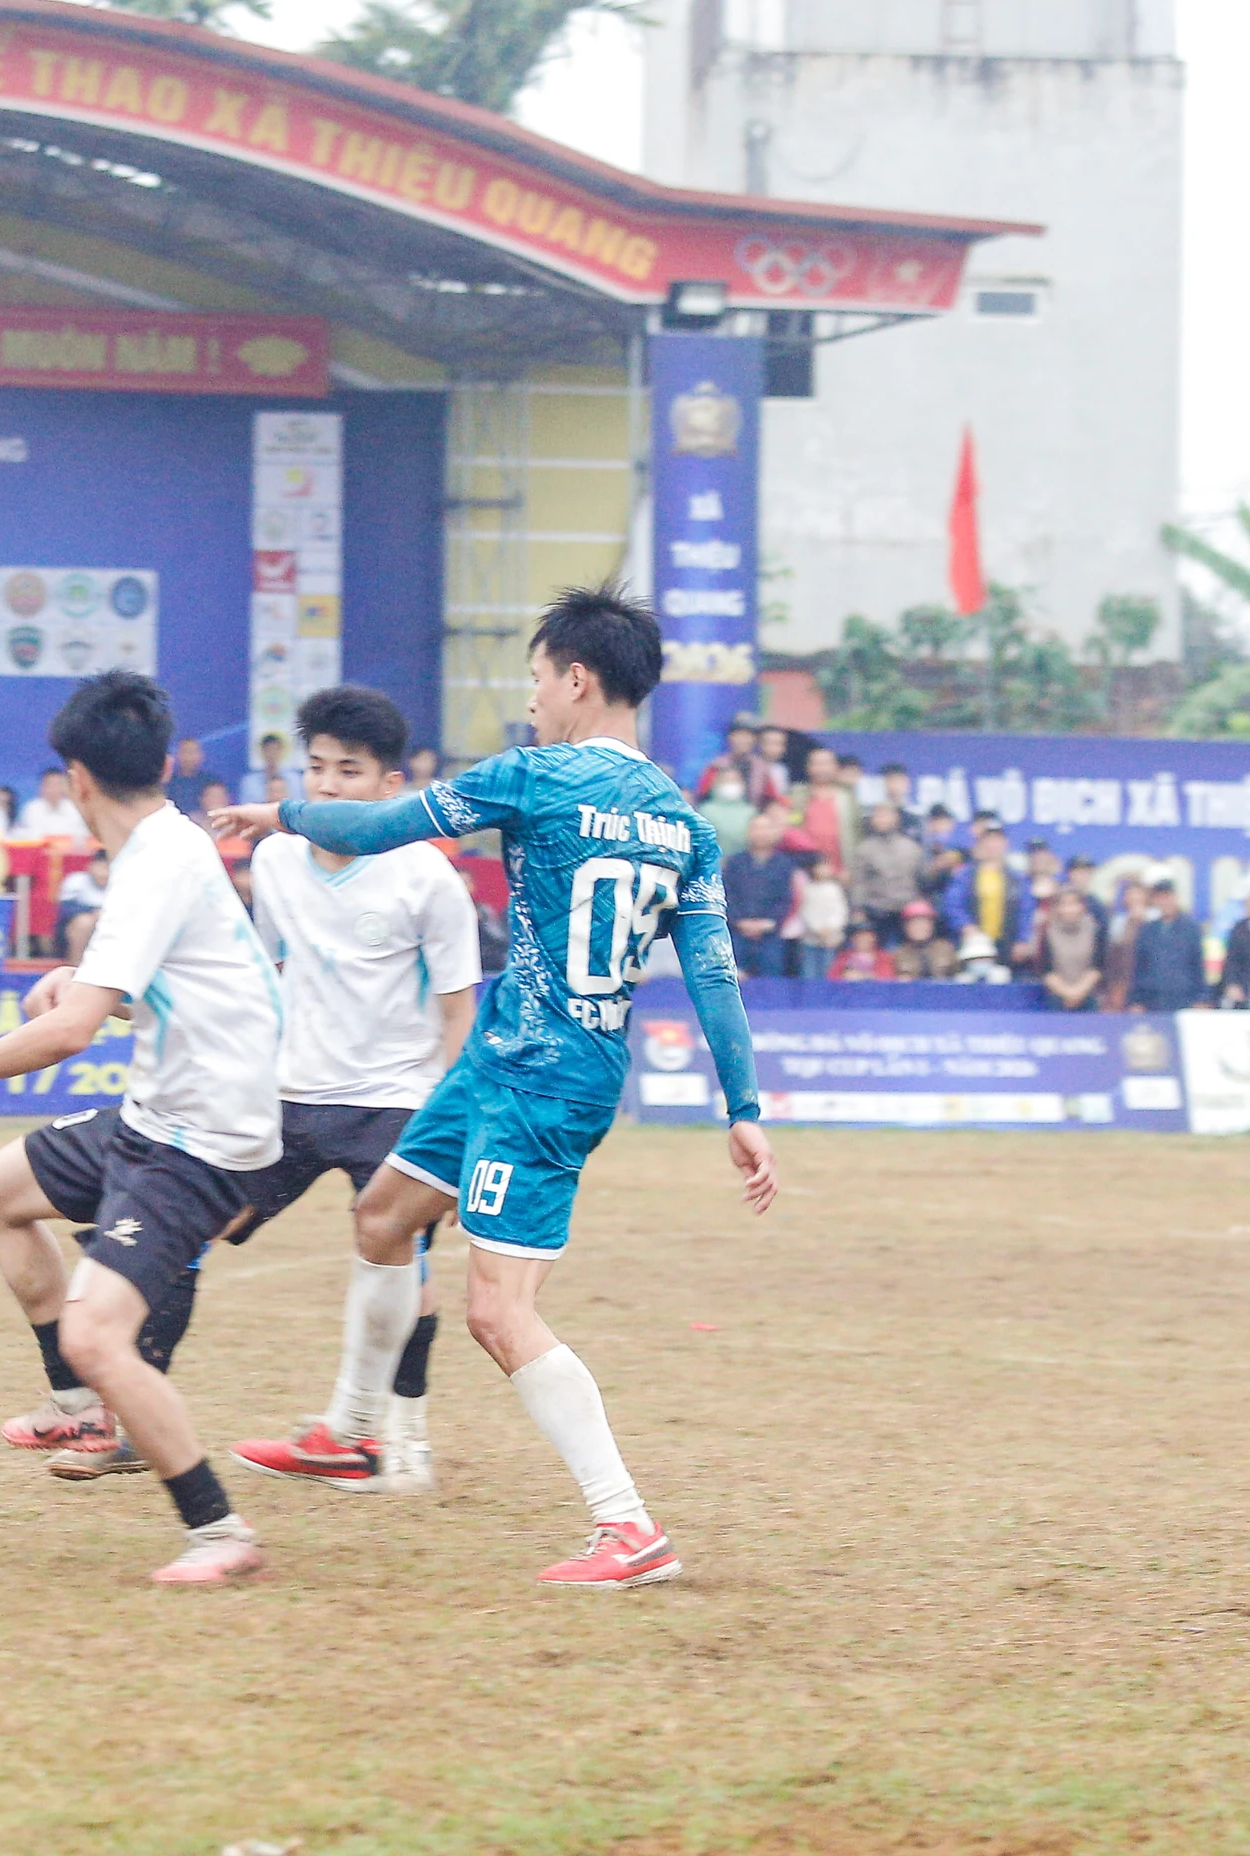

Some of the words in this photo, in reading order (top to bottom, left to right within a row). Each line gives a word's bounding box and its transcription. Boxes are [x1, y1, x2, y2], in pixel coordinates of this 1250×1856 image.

[27, 49, 188, 124] THAO
[203, 84, 292, 152] XÃ
[483, 177, 659, 281] QUANG
[577, 804, 630, 842] Trúc
[1127, 772, 1182, 828] XÃ
[467, 1160, 514, 1217] 09
